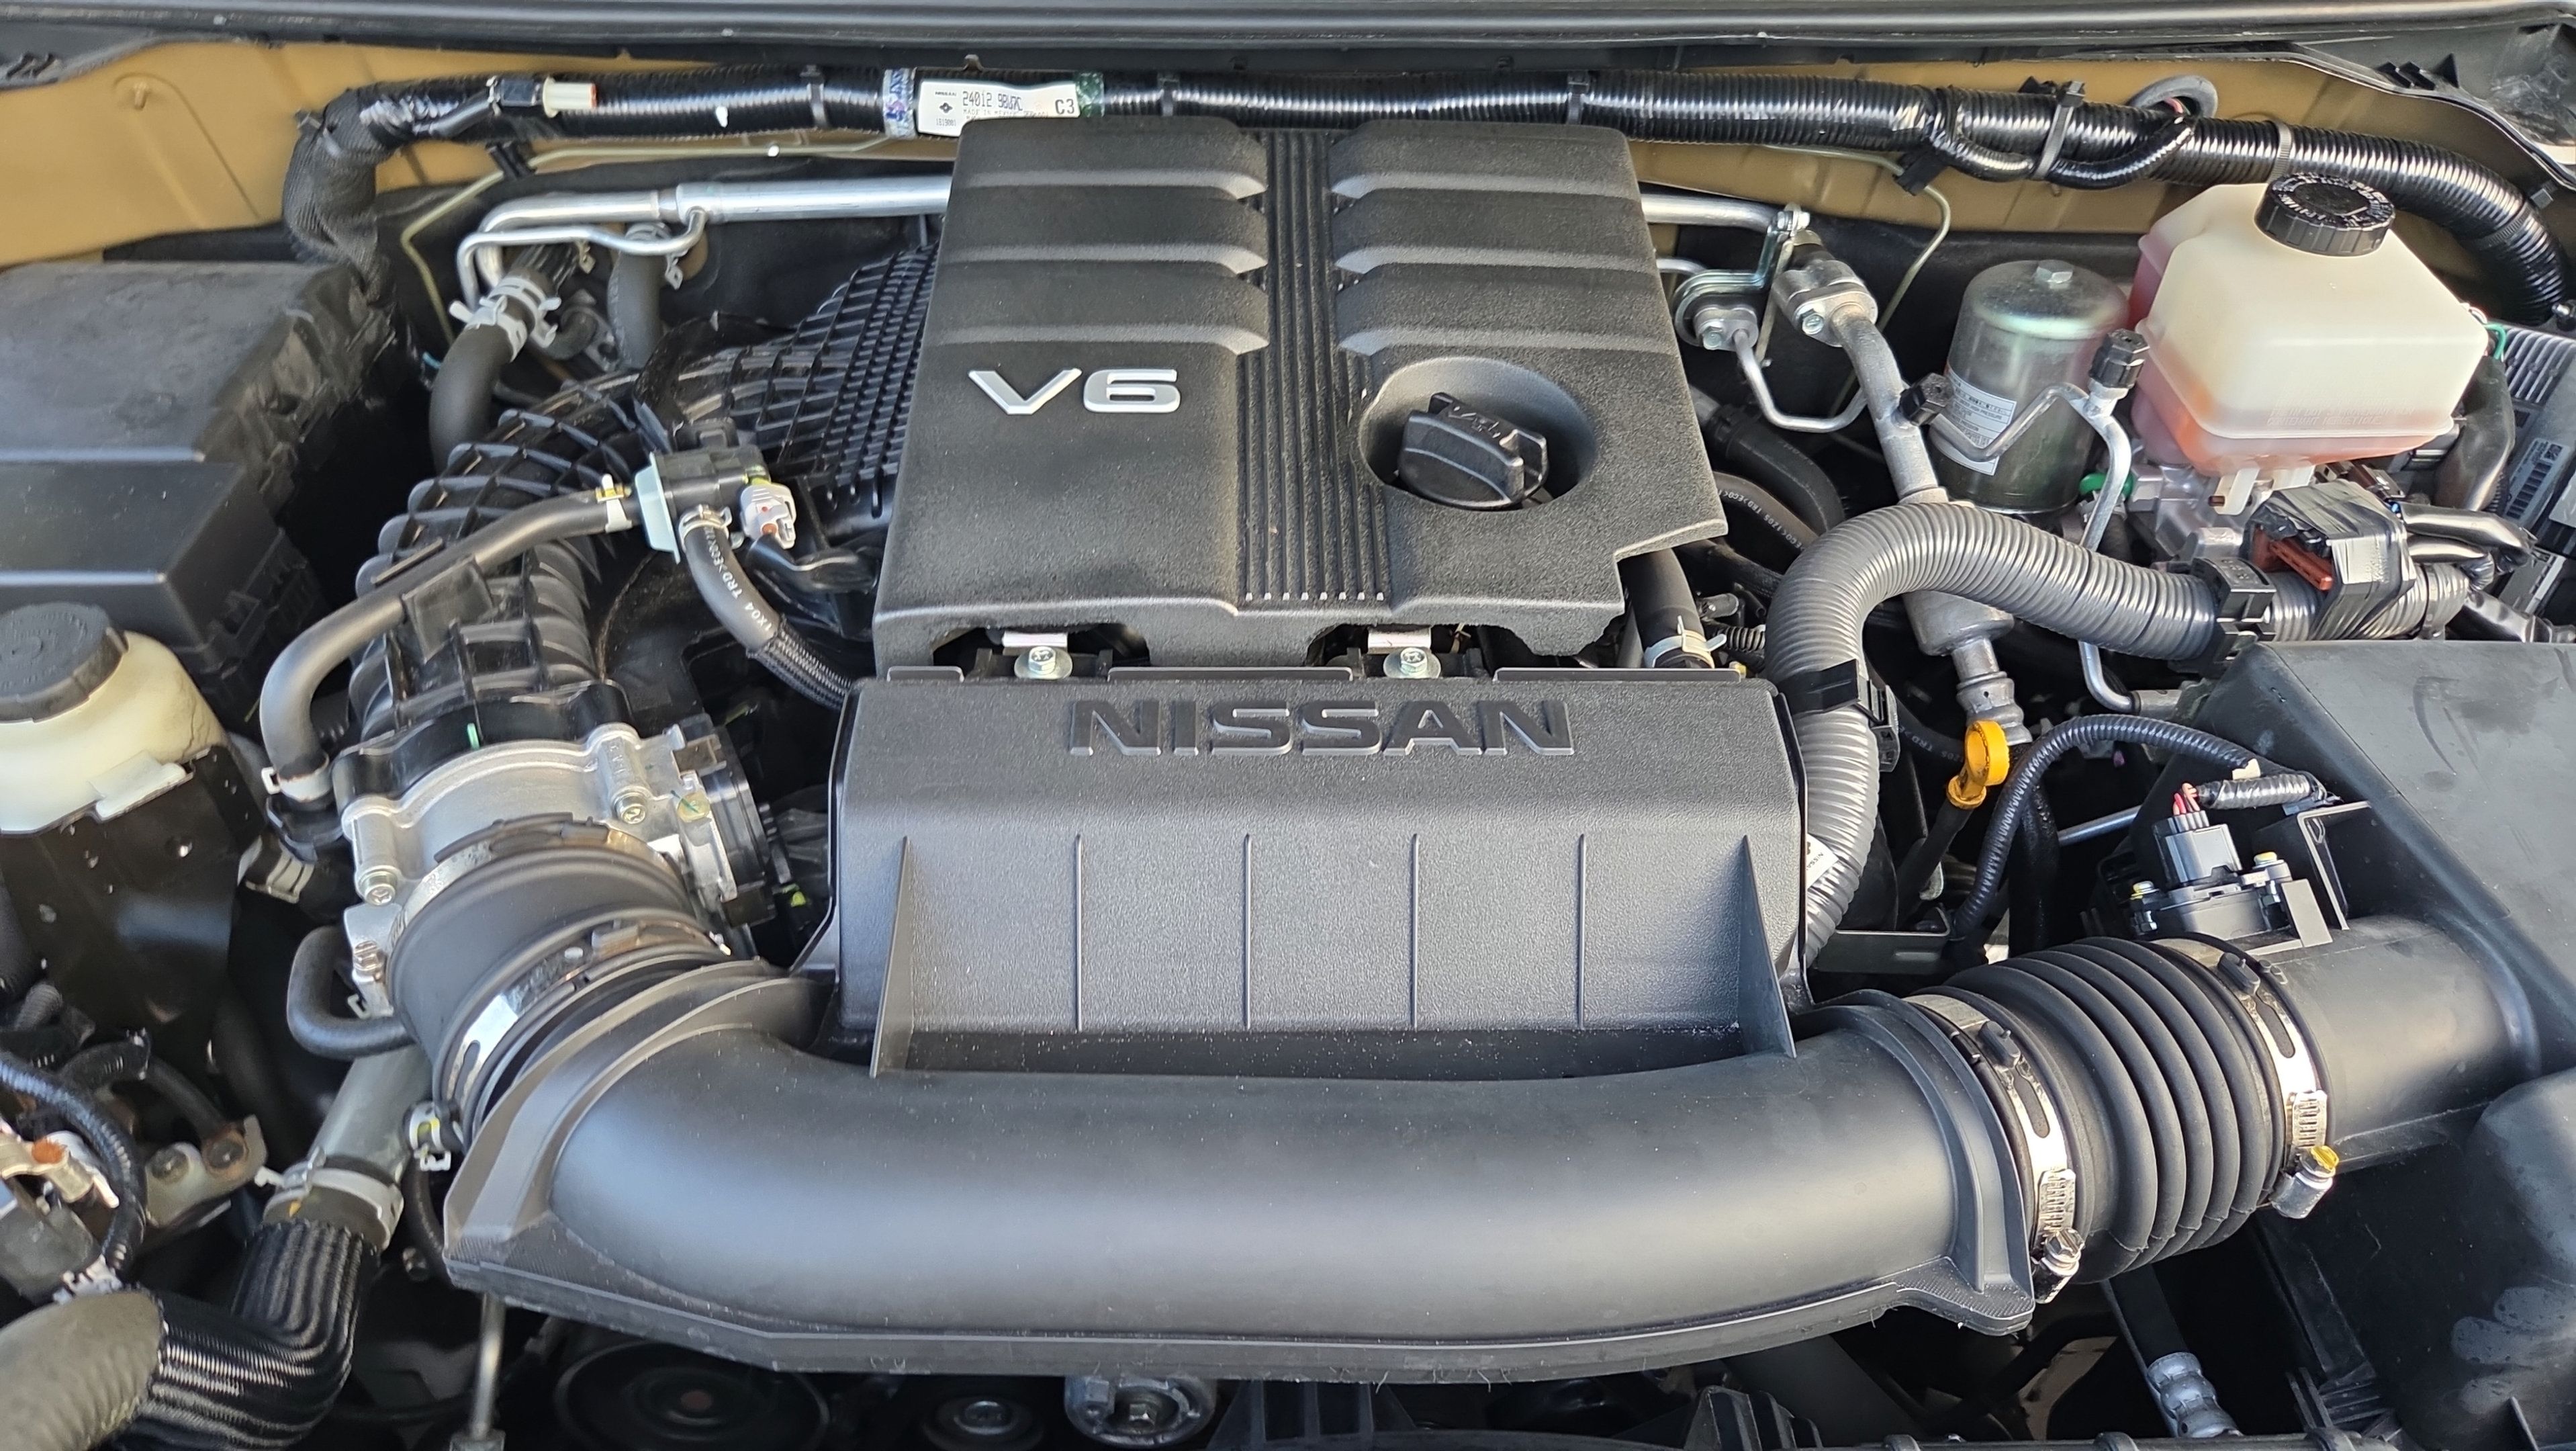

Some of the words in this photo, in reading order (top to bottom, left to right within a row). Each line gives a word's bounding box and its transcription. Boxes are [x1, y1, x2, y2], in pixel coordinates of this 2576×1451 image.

[962, 91, 993, 107] 24012
[1054, 98, 1074, 115] C3
[968, 367, 1181, 415] V6
[1070, 699, 1574, 756] NISSAN
[1806, 852, 1824, 871] NISSA
